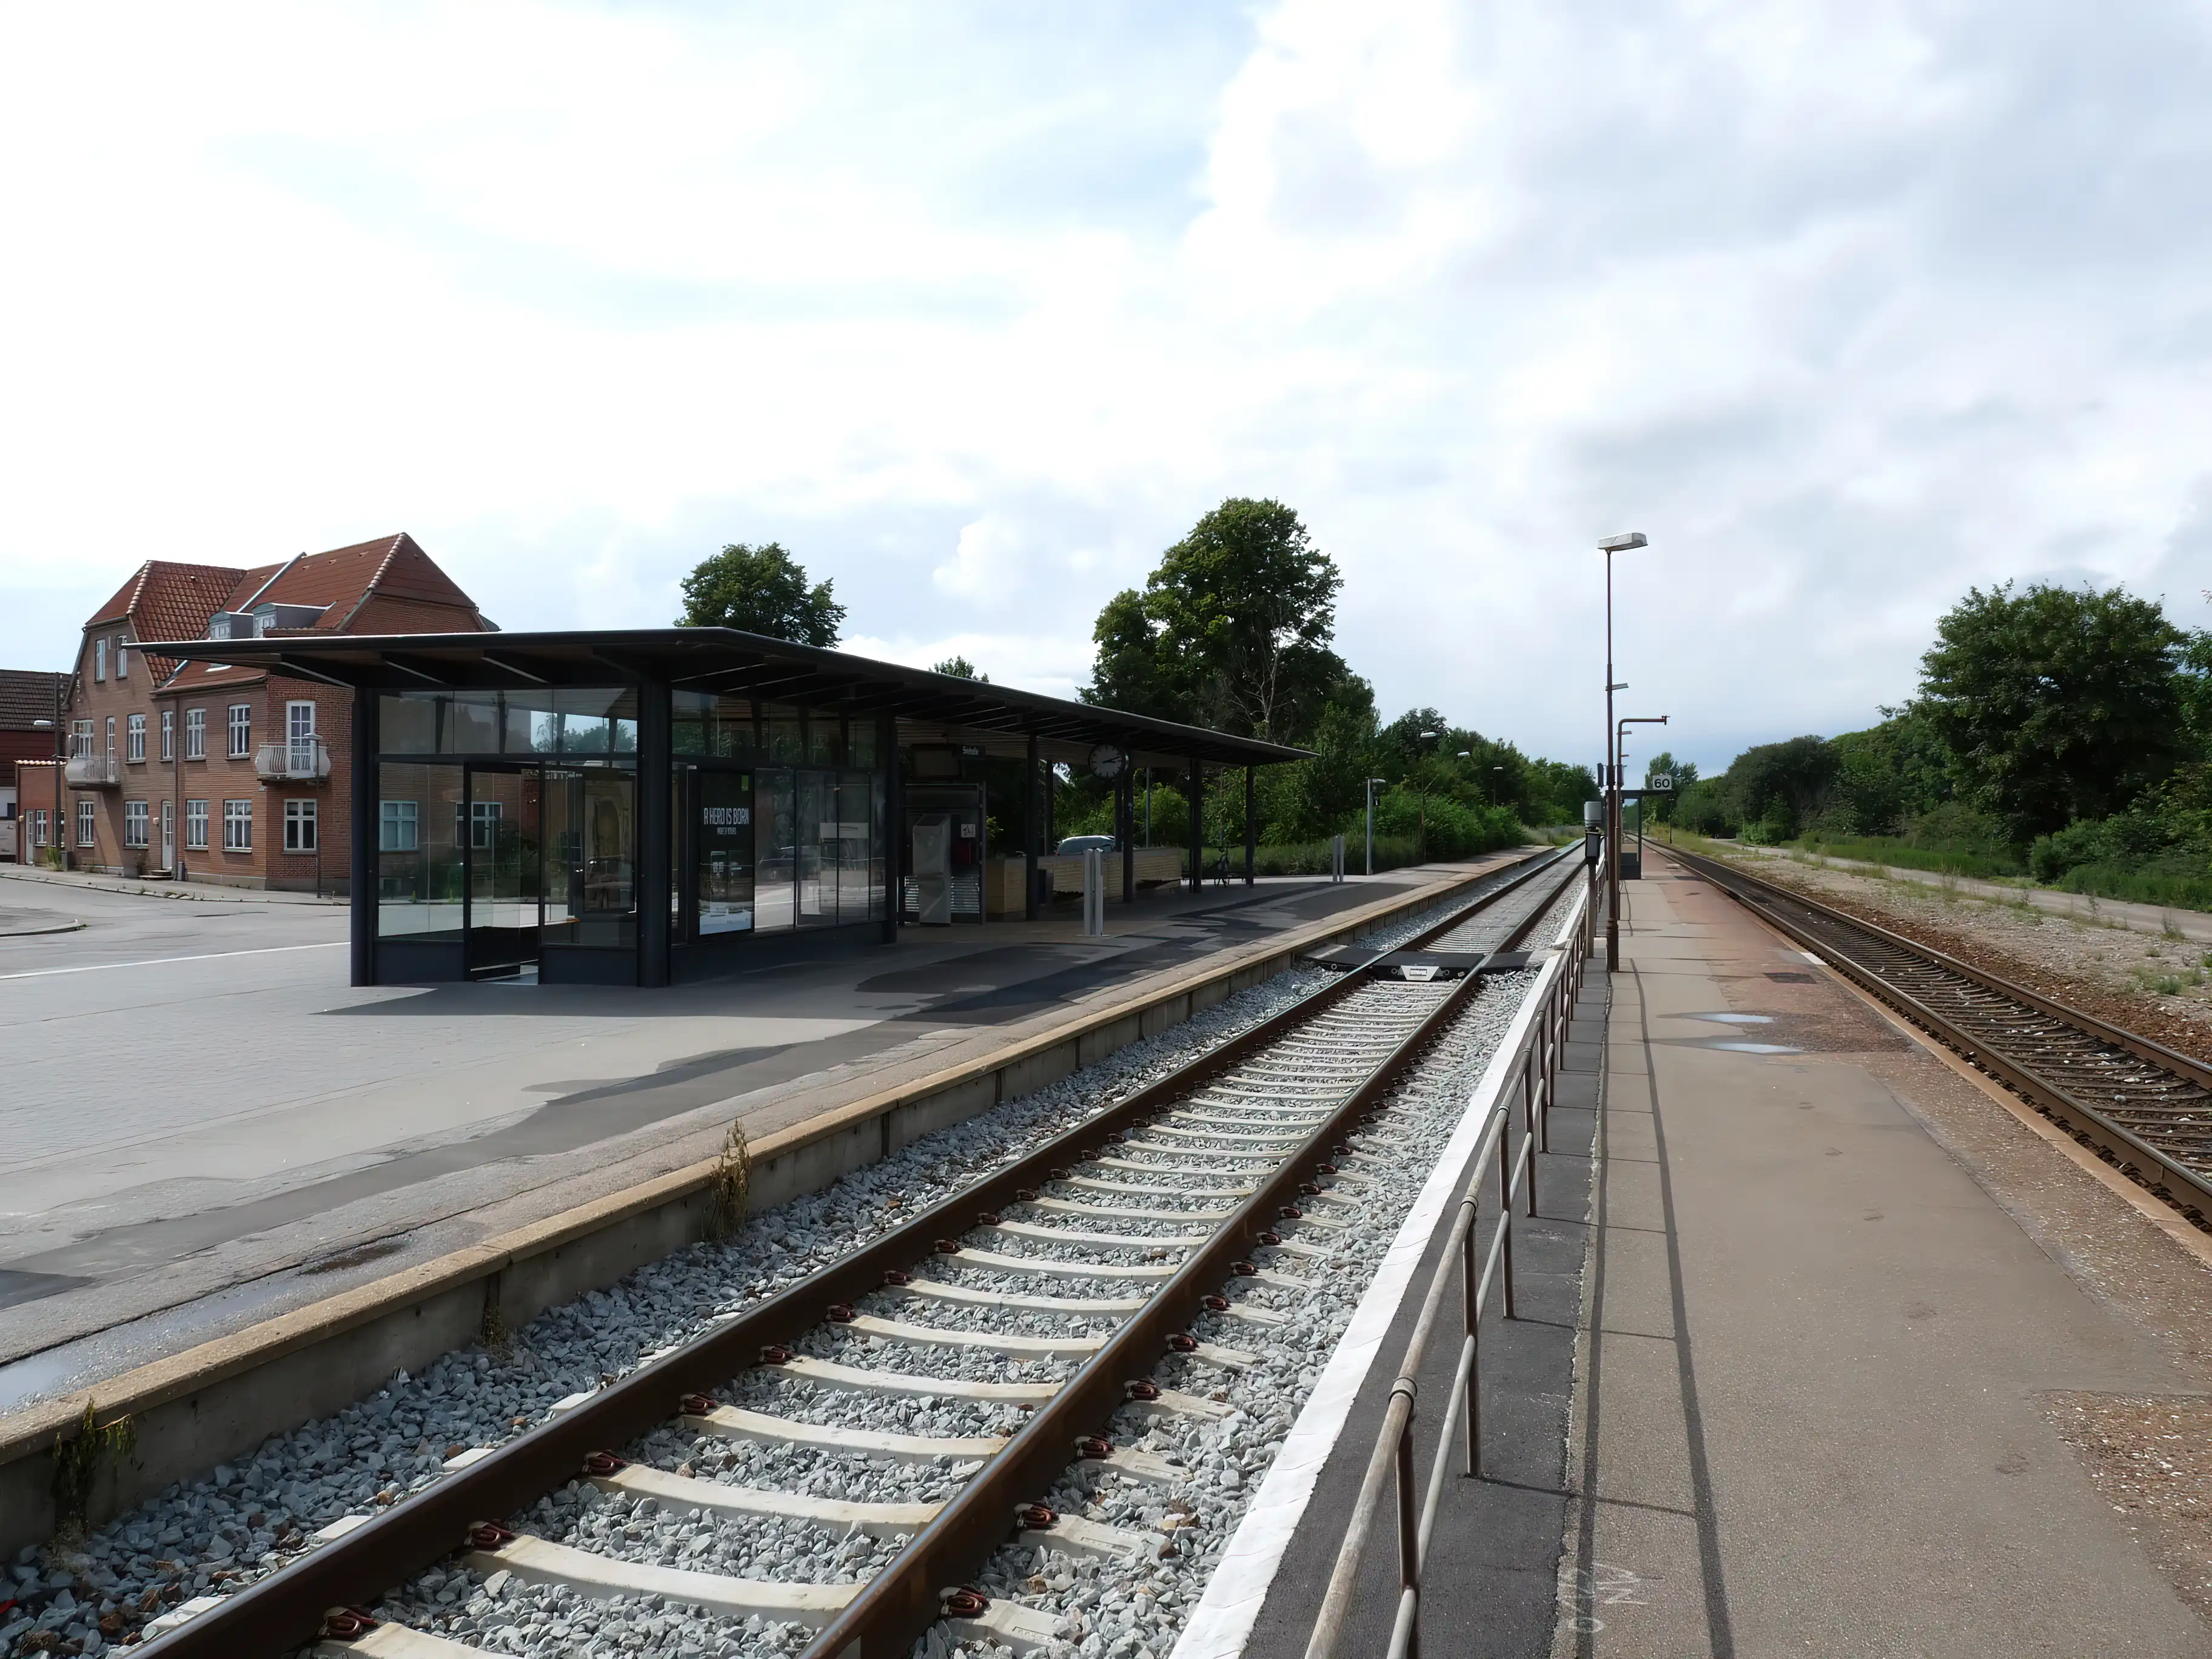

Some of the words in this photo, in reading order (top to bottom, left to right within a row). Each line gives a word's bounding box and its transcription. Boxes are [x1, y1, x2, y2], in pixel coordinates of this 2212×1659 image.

[1654, 779, 1670, 788] 60
[703, 808, 709, 825] A
[709, 808, 725, 825] HERO
[726, 808, 732, 825] IS
[732, 808, 749, 825] BORN
